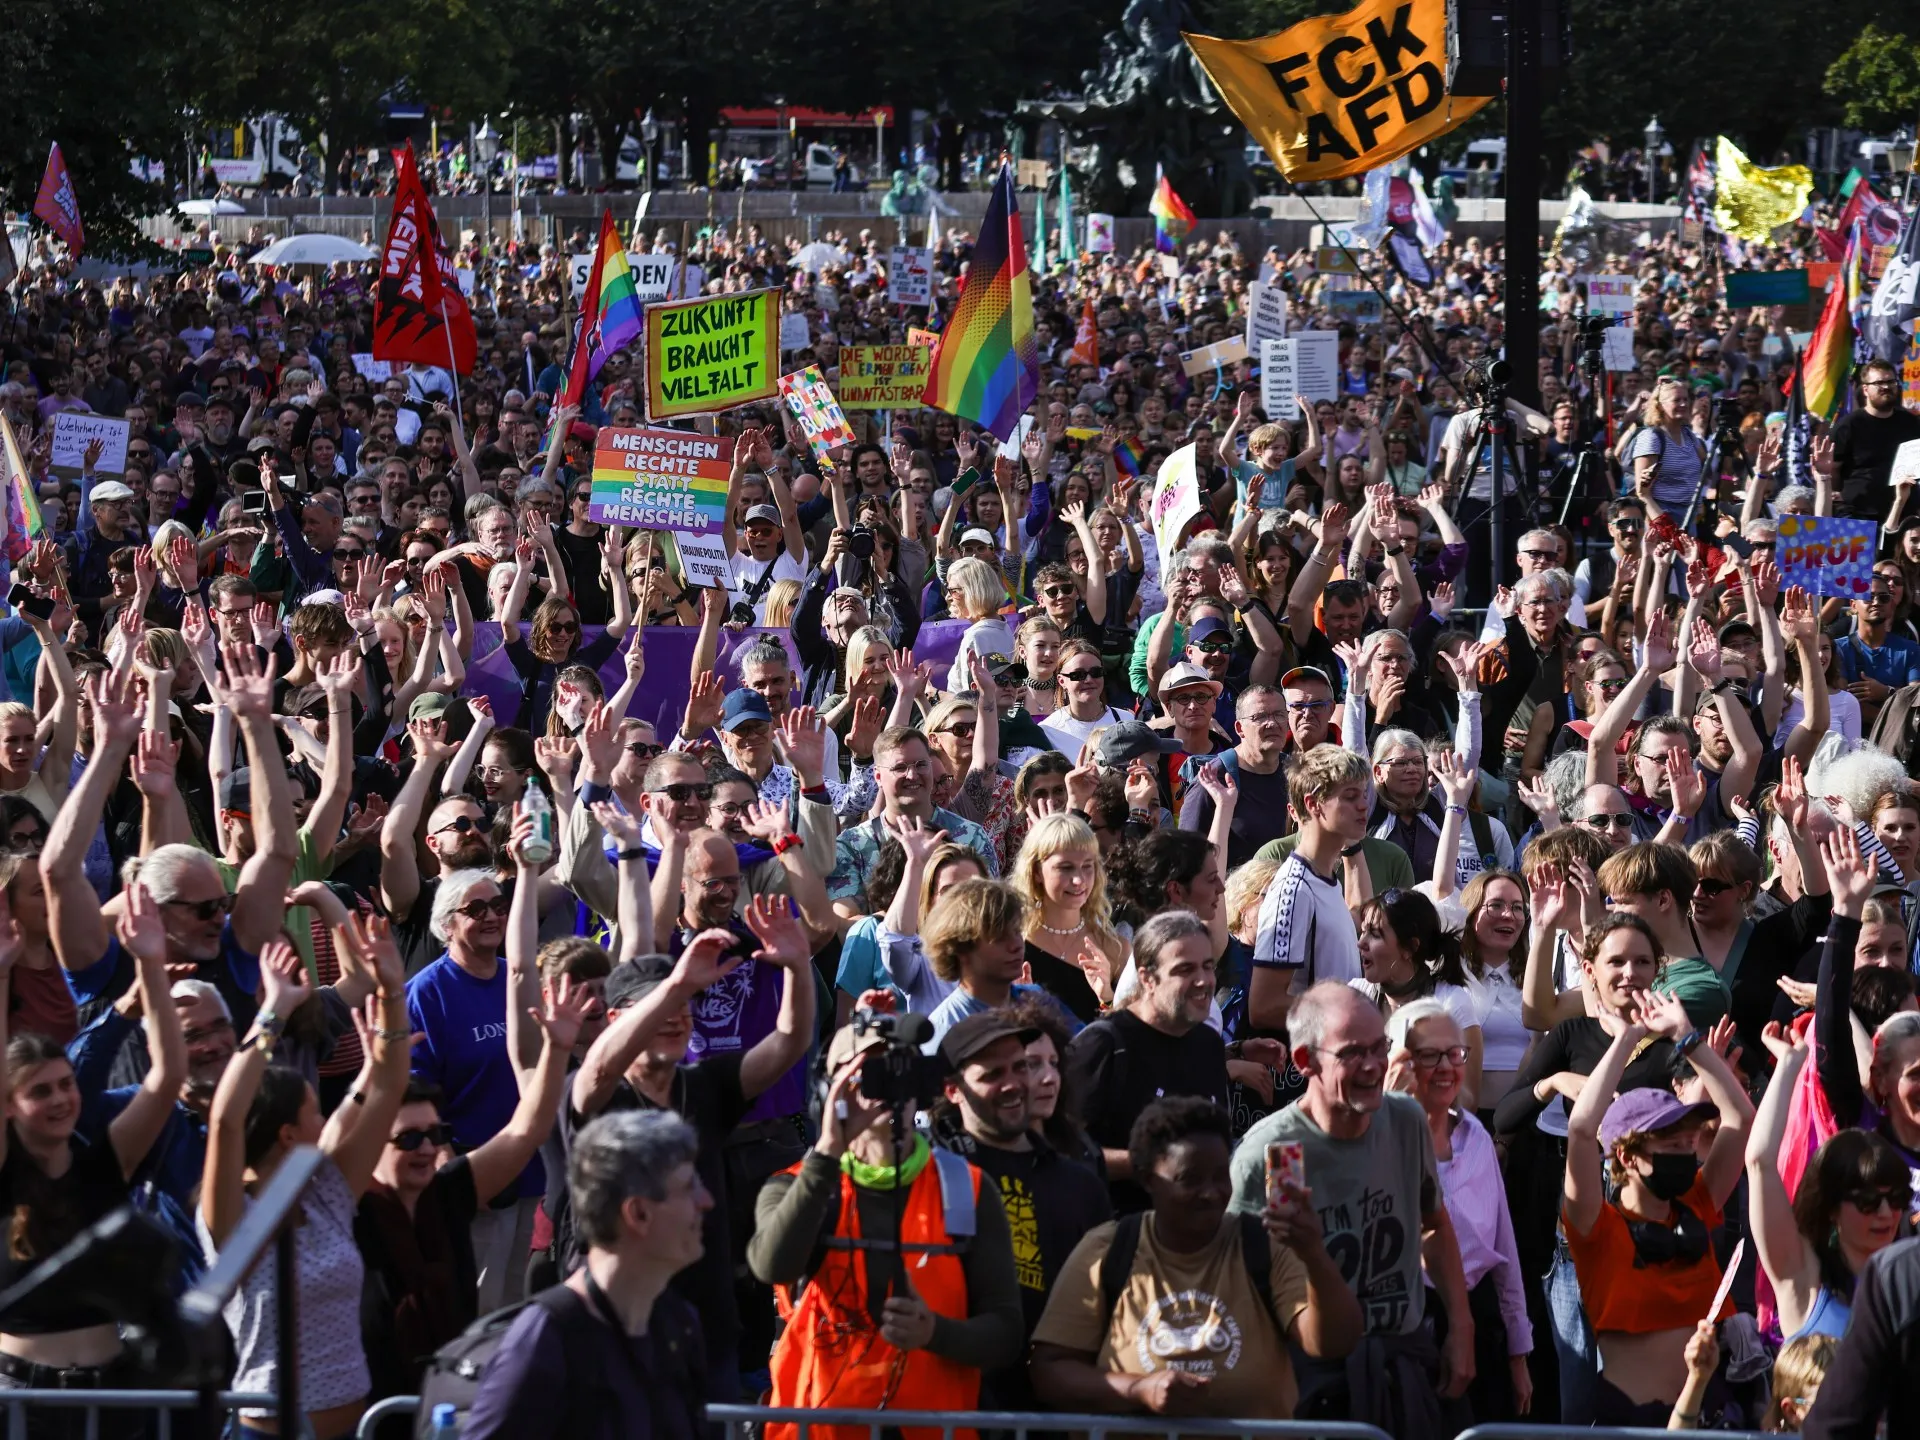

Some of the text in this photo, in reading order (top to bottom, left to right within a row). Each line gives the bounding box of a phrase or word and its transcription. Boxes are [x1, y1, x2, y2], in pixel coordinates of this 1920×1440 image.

[1266, 3, 1427, 112] FCK
[1307, 61, 1443, 162] AFD
[577, 265, 667, 285] SDEN
[1259, 302, 1279, 314] GEGEN
[1261, 292, 1279, 304] OMAS
[662, 294, 763, 338] ZUKUNFT
[1256, 312, 1280, 325] RECHTS
[668, 330, 755, 372] BRAUCHT
[841, 348, 864, 362] DIE
[662, 362, 759, 401] VIELFALT
[874, 377, 892, 385] IST
[787, 382, 833, 413] BLEIB
[58, 416, 123, 437] Wehrhaft ist
[798, 403, 845, 438] BUNT
[612, 434, 719, 459] MENSCHEN
[624, 453, 700, 475] RECHTE
[633, 472, 693, 492] STATT
[620, 488, 696, 510] RECHTE
[602, 504, 709, 528] MENSCHEN
[691, 563, 701, 574] IST
[472, 1023, 506, 1042] LON
[1318, 1187, 1395, 1237] I'M too
[1326, 1216, 1404, 1299] OLD
